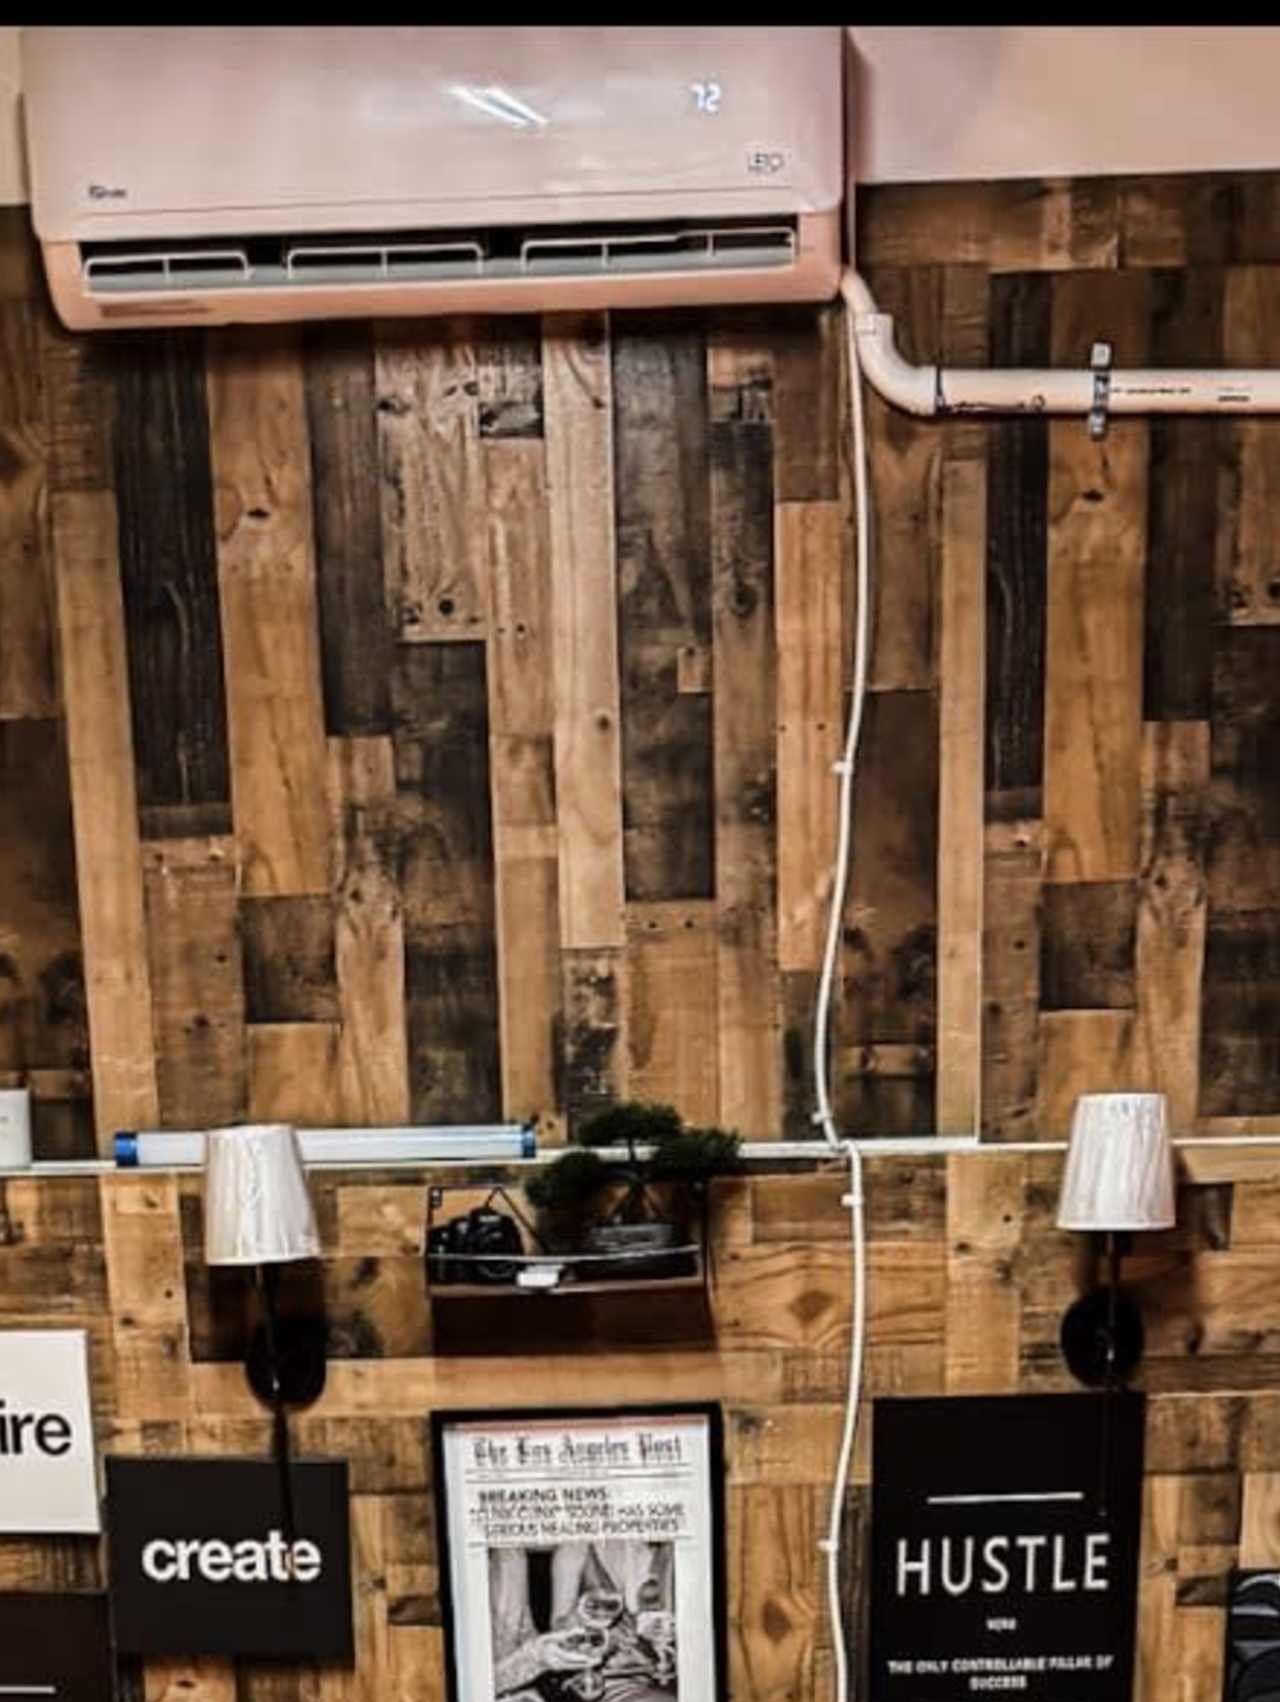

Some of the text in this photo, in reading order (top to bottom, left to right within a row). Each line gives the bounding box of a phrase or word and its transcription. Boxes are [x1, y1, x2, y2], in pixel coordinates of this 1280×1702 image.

[477, 1488, 557, 1503] BREAKING
[141, 1529, 322, 1582] create
[896, 1533, 1111, 1596] HUSTLE
[886, 1659, 913, 1674] THE
